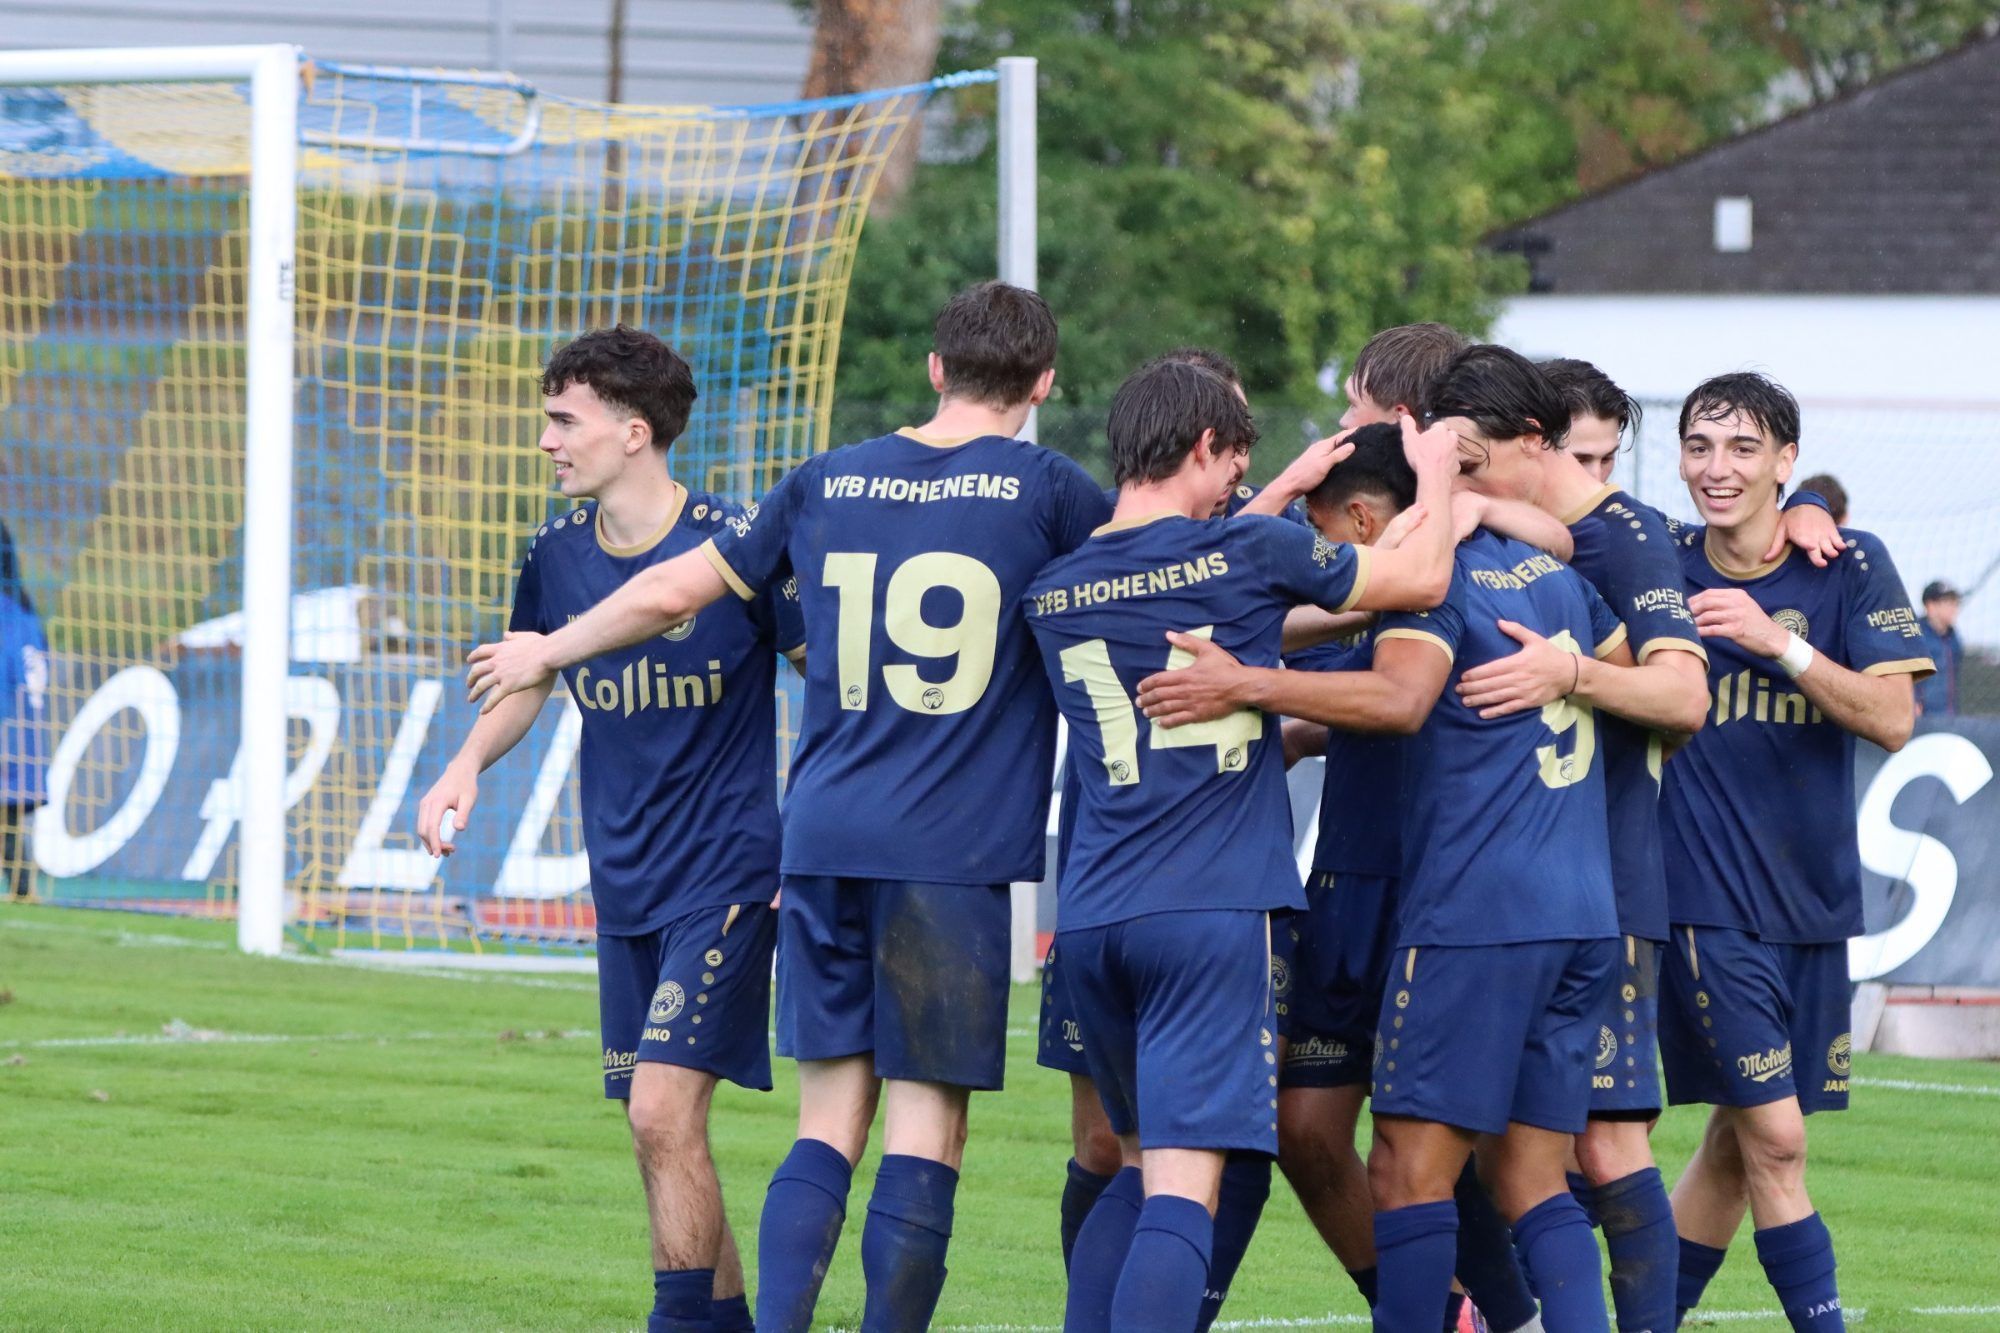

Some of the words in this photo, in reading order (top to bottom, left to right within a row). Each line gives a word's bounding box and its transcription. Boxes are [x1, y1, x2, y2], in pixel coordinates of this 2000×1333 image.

[824, 475, 866, 499] VfB
[867, 473, 1020, 503] HOHENEMS
[1034, 589, 1069, 616] VfB
[1073, 552, 1230, 609] HOHENEMS
[822, 551, 1001, 716] 19
[575, 655, 723, 719] Collini
[1059, 624, 1263, 787] 14
[1823, 1079, 1850, 1092] JAK
